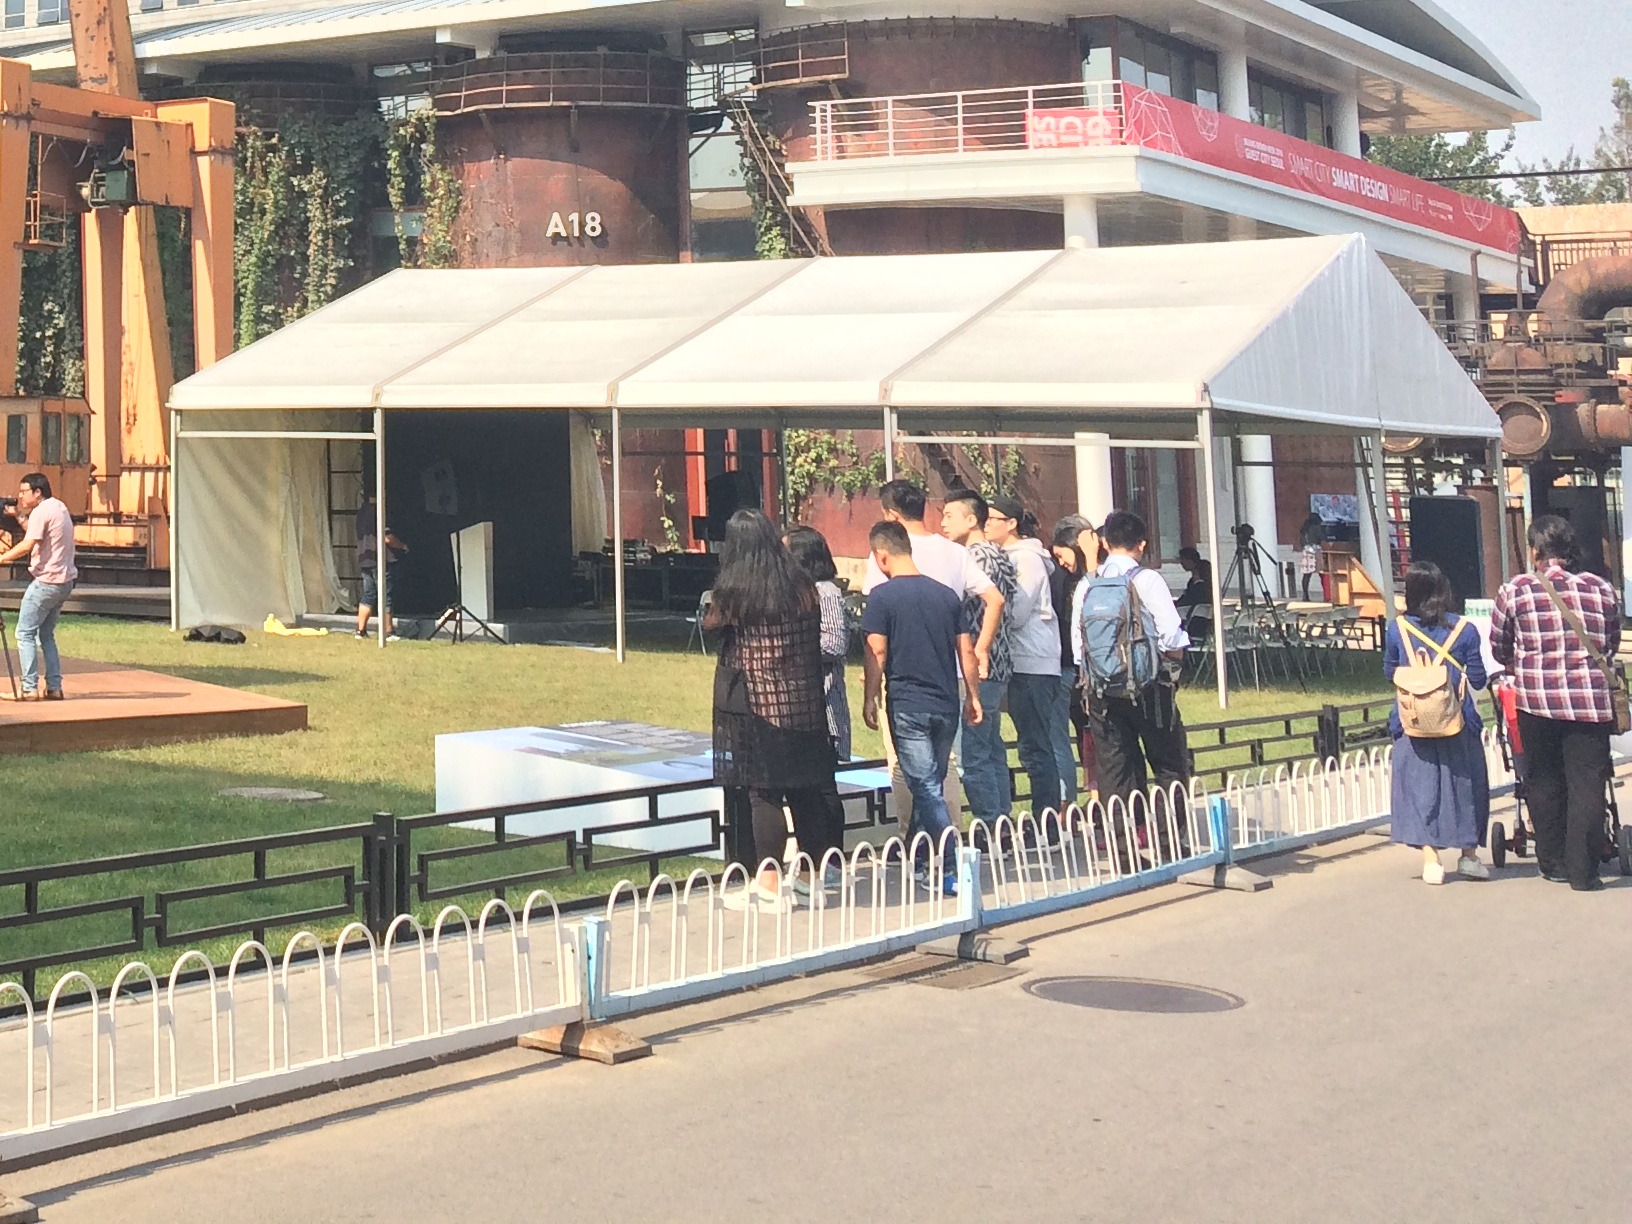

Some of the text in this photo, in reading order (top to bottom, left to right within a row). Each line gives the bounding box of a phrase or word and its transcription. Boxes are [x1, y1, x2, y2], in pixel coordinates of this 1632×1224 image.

[1288, 152, 1314, 180] SMART
[1314, 161, 1331, 184] CITY
[1331, 167, 1360, 194] SMART
[1359, 176, 1389, 202] DESIGN
[1388, 184, 1411, 208] SMART
[1411, 192, 1426, 214] LIFE
[545, 211, 602, 237] A18
